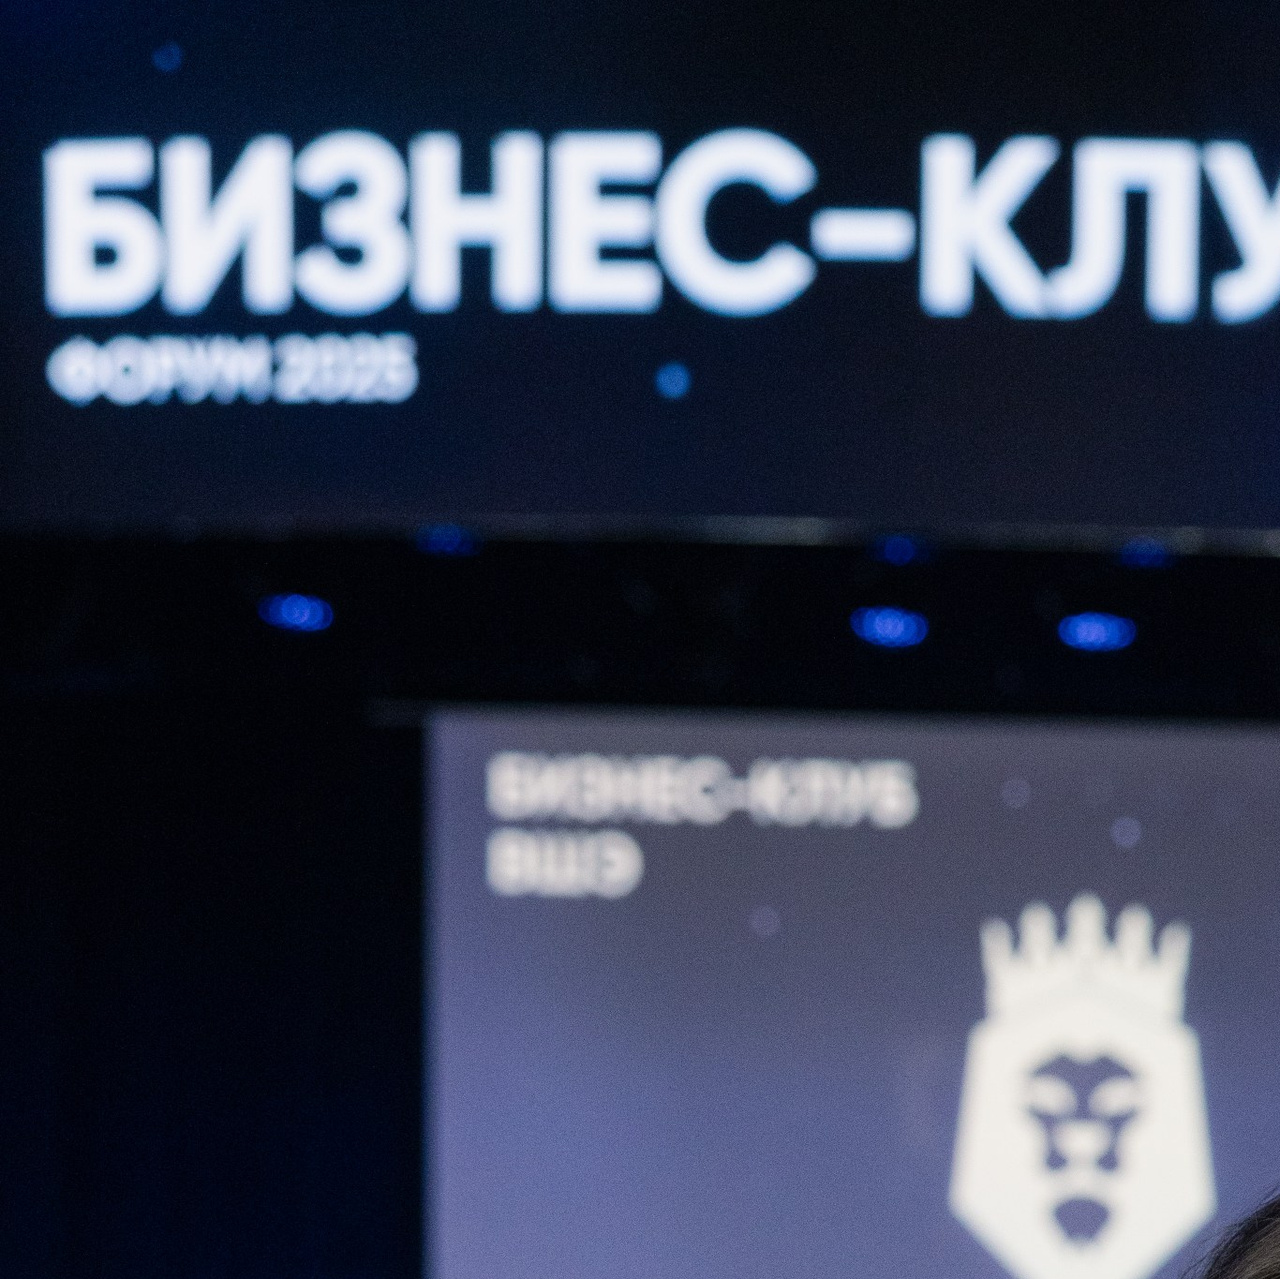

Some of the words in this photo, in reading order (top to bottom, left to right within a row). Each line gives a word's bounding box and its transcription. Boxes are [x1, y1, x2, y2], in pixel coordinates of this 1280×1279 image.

[47, 335, 271, 405] ФОРУМ
[487, 752, 917, 826] БИЗНЕС-КЛУБ
[487, 828, 642, 897] ВШЭ
